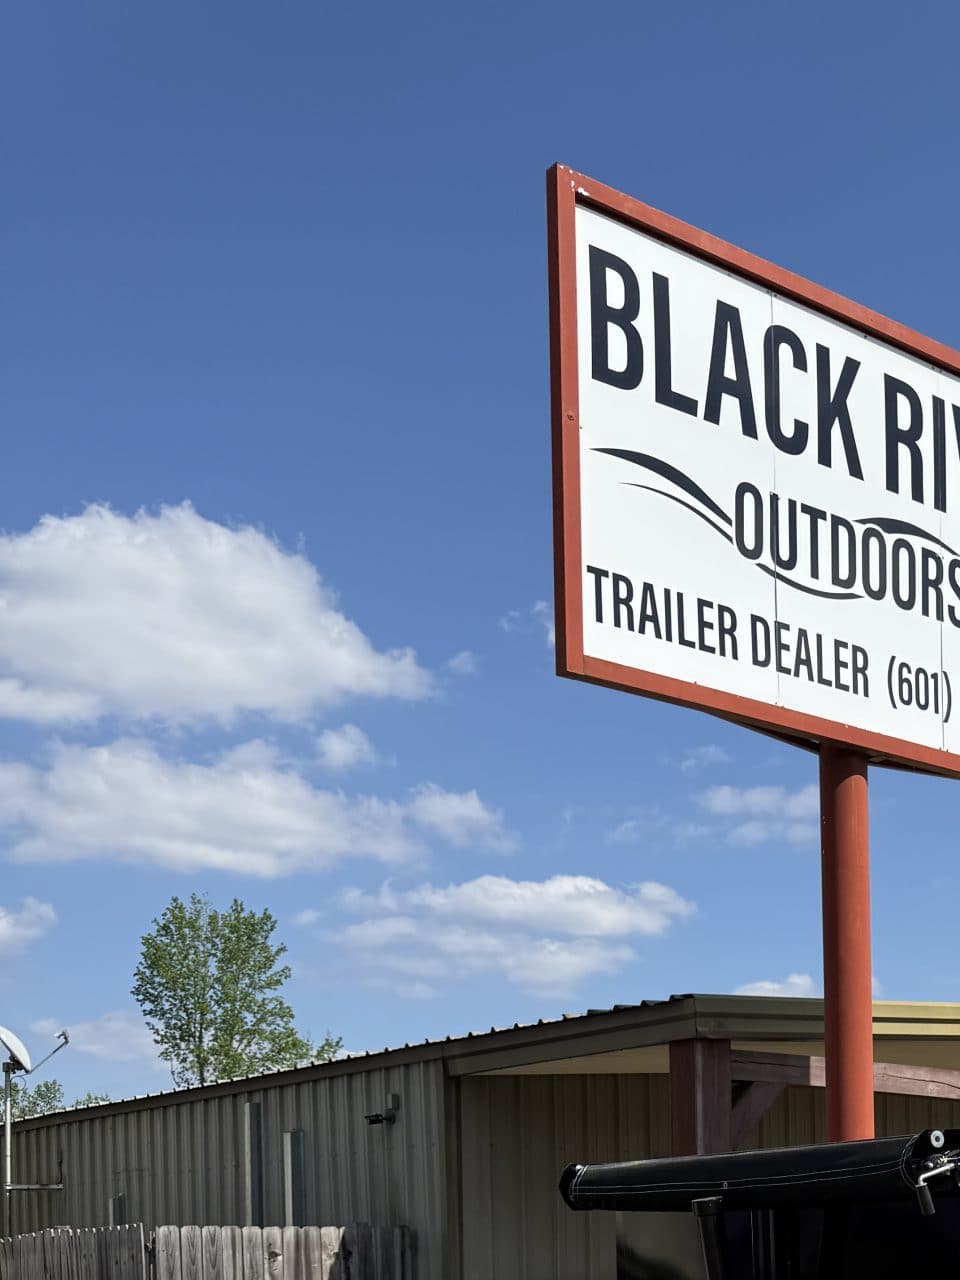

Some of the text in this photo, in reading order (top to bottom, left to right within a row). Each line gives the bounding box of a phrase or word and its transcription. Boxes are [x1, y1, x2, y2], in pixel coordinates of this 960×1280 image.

[588, 244, 865, 482] BLACK
[586, 564, 739, 661] TRAILER
[750, 613, 869, 698] DEALER
[887, 655, 952, 723] (601)
